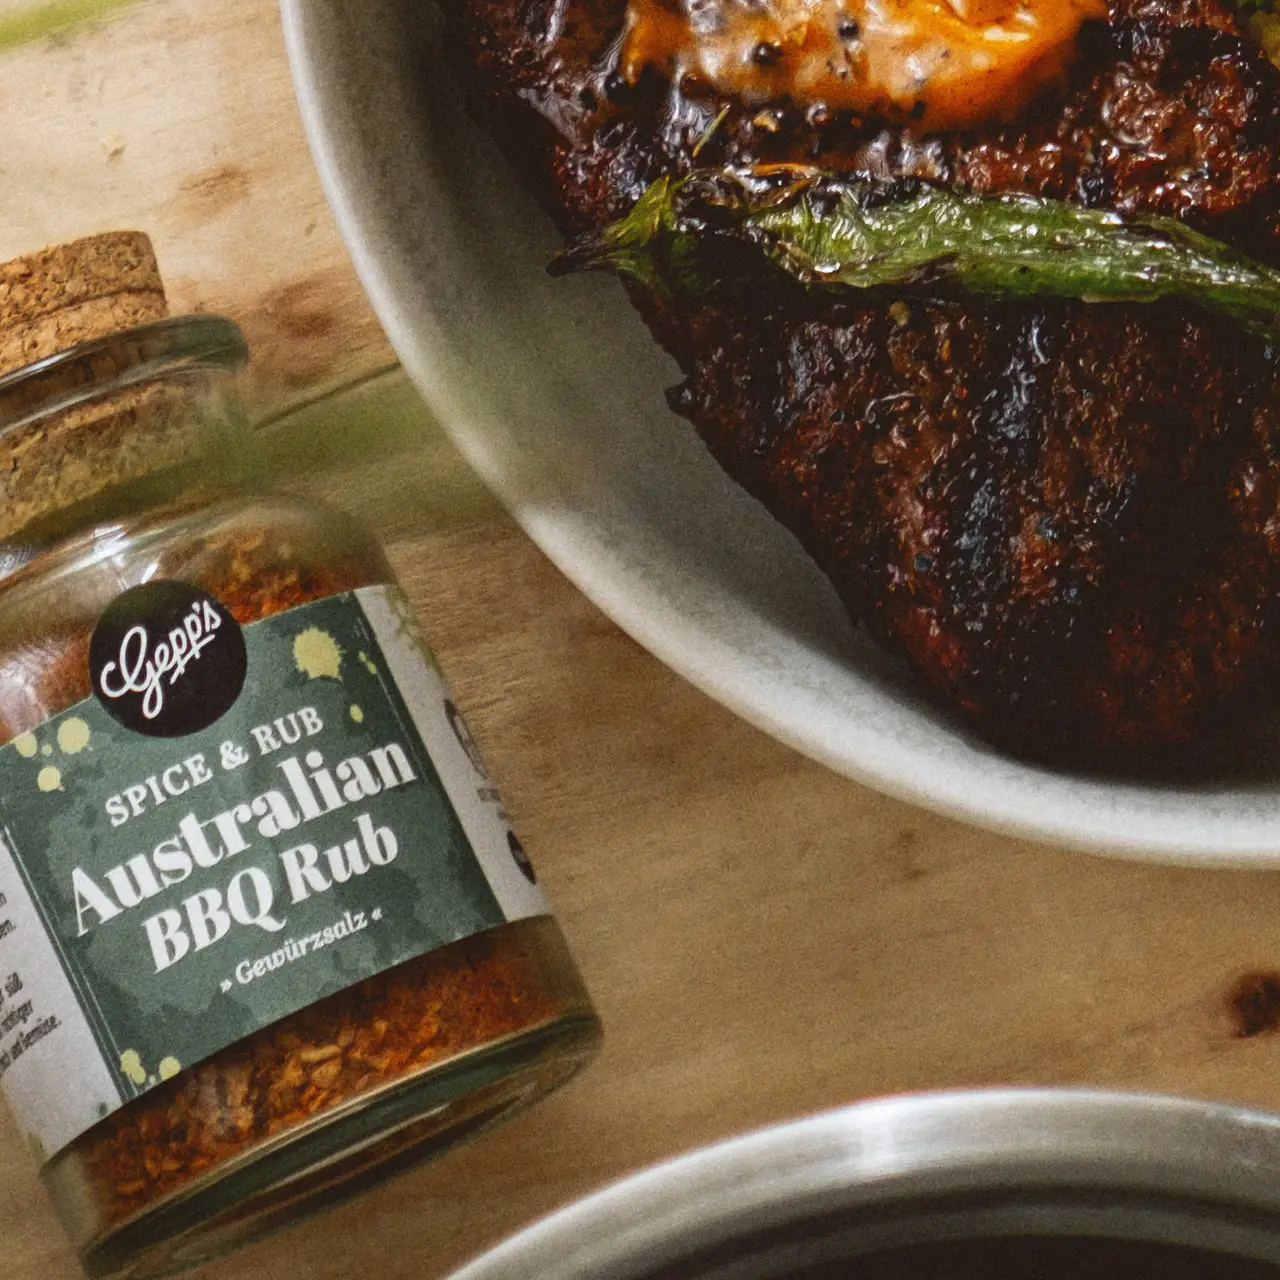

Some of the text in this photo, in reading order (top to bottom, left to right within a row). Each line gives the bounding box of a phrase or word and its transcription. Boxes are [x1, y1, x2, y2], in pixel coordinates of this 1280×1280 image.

[100, 599, 222, 720] Gepp's
[105, 707, 324, 827] SPICE & RUB
[71, 742, 418, 938] Australian
[141, 812, 399, 975] BBQ Rub
[234, 908, 369, 986] Gewürzsalz
